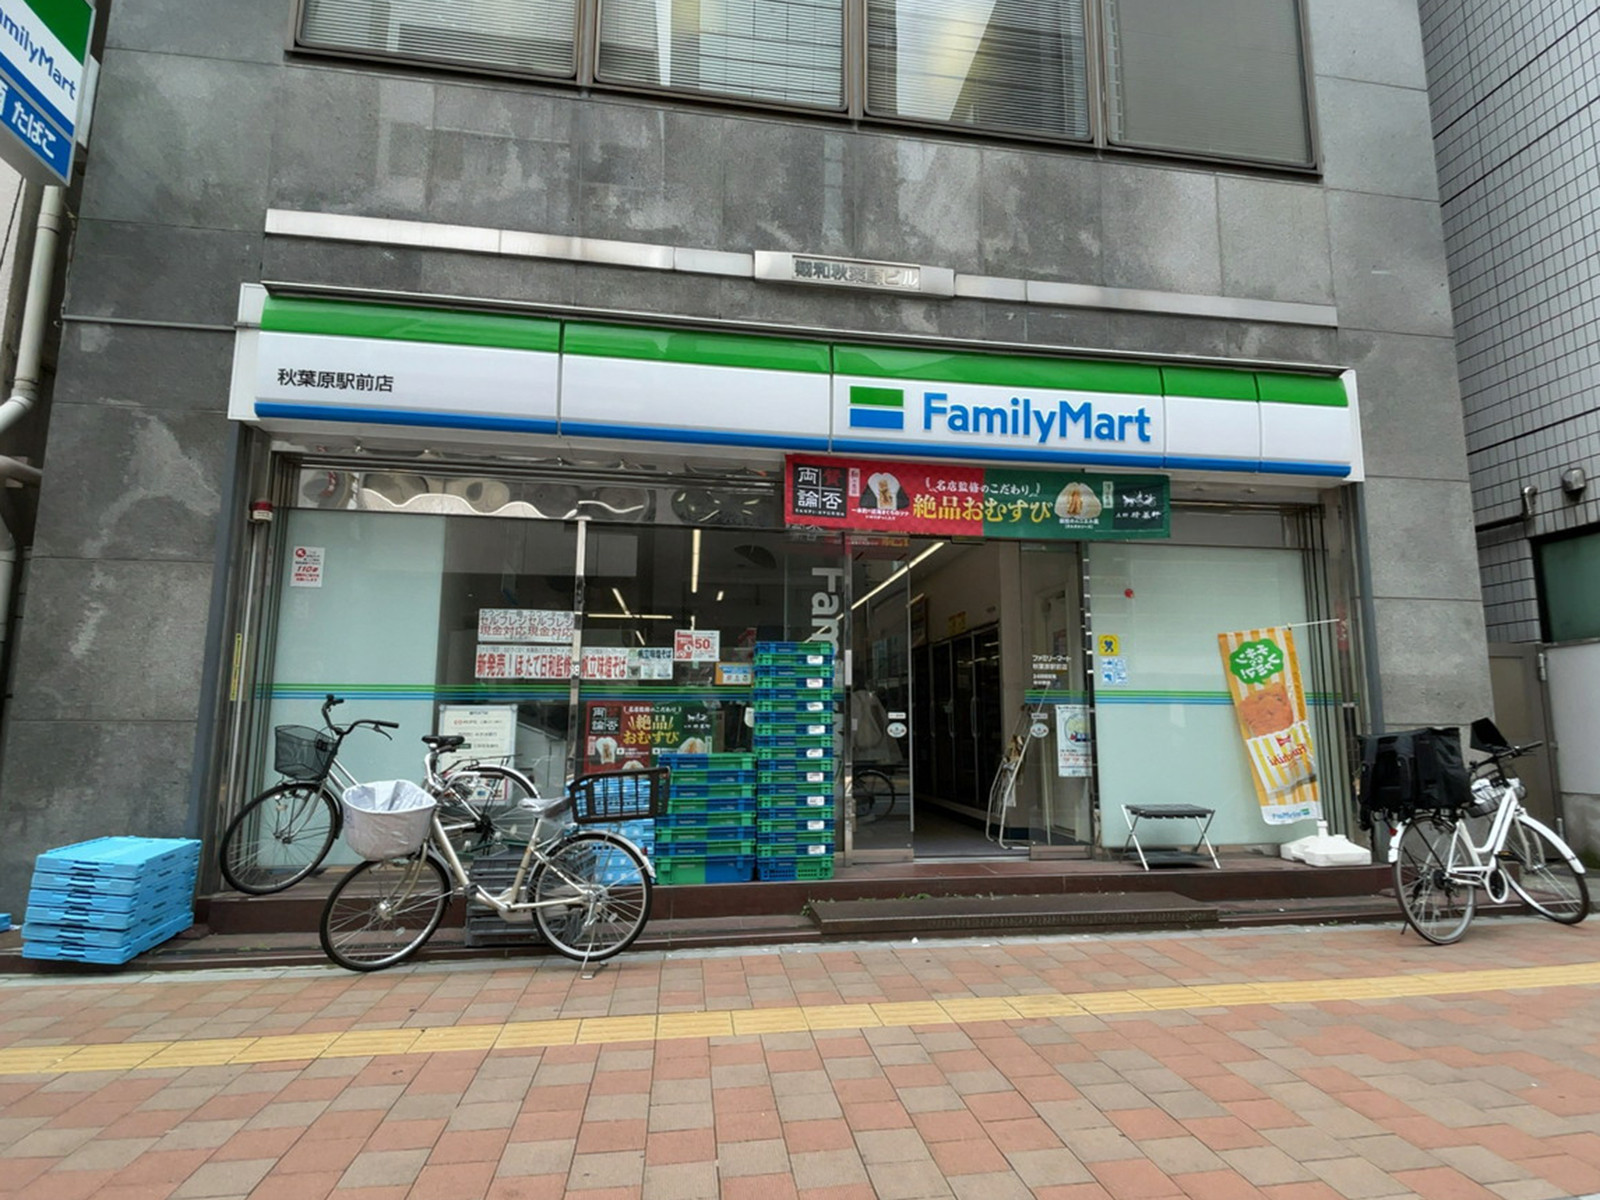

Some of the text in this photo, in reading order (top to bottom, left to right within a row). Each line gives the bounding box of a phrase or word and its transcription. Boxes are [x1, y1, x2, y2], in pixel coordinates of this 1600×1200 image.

[12, 101, 57, 160] たばこ
[277, 367, 394, 393] 秋葉原駅前店
[923, 392, 1151, 443] FamilyMart
[912, 493, 1053, 523] 絶品おむすび
[623, 731, 679, 745] おむすび
